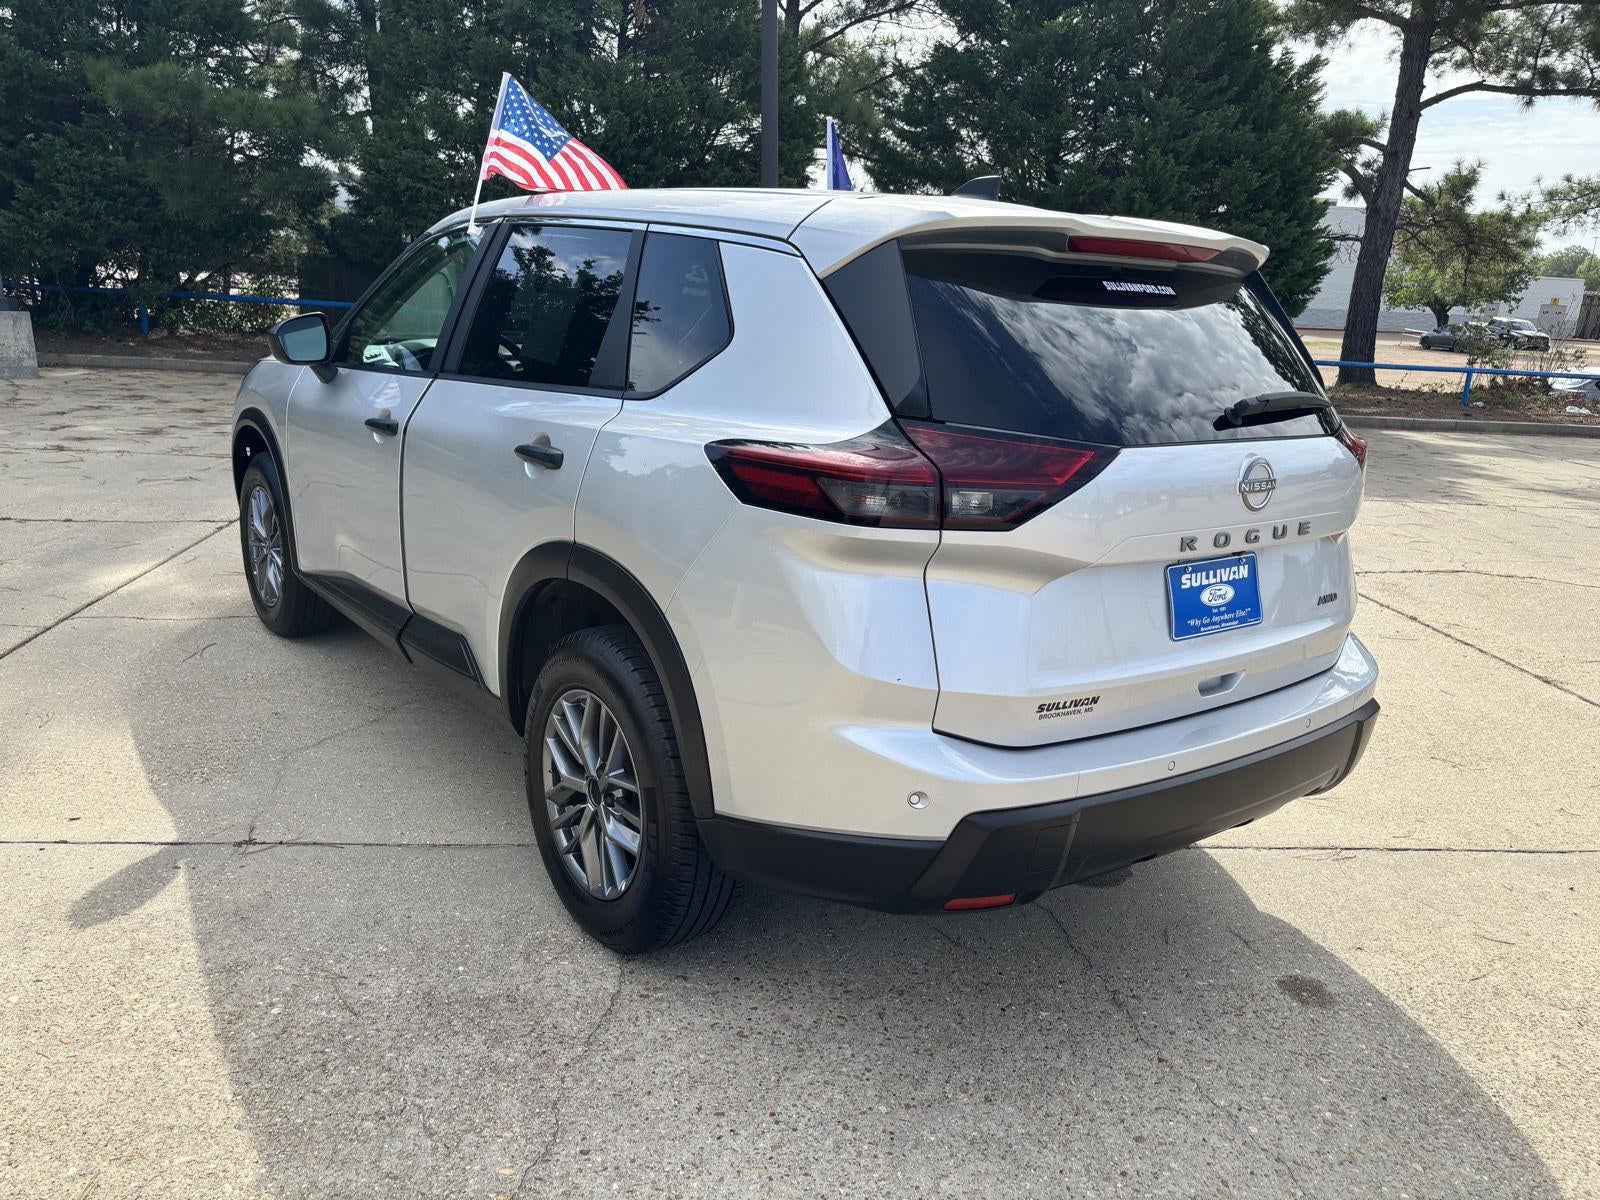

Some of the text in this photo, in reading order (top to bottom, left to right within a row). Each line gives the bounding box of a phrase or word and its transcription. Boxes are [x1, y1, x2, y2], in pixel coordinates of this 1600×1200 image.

[1102, 280, 1177, 295] SULLIVANFORD.COM
[1240, 478, 1276, 492] NISSAN
[1179, 520, 1311, 552] ROGUE
[1180, 564, 1249, 589] SULLIVAN
[1207, 586, 1228, 603] Ford
[1202, 616, 1211, 625] Go
[1211, 612, 1235, 623] Anywhere
[1035, 695, 1101, 714] SULLIVAN
[1038, 706, 1094, 721] BROOKHAVEN, MS
